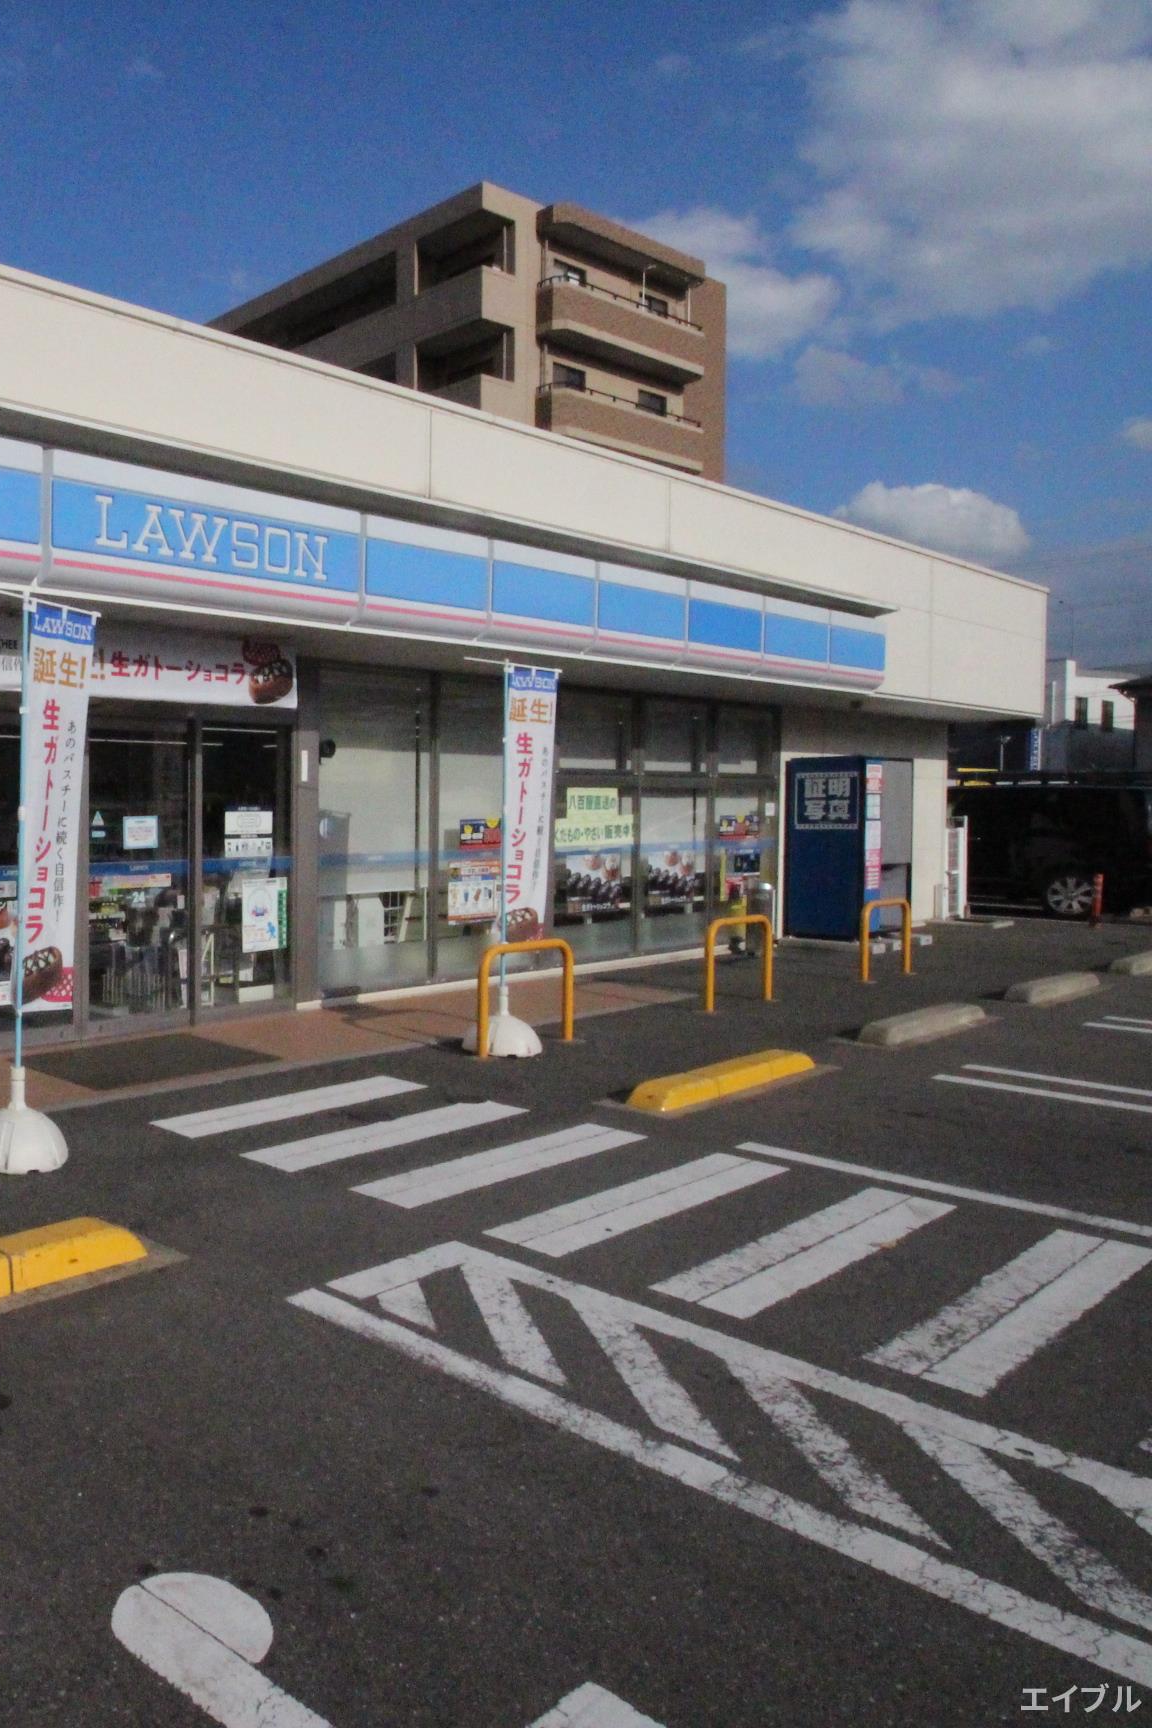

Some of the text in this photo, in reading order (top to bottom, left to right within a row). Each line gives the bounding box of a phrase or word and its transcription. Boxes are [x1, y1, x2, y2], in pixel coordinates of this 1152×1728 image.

[95, 495, 328, 581] LAWSON
[35, 614, 92, 641] LAWSON
[111, 651, 248, 685] 生ガトーショコラ
[511, 674, 556, 690] LAWSON
[25, 698, 60, 944] 生ガトーショコラ
[505, 732, 534, 905] 生ガトーショコラ
